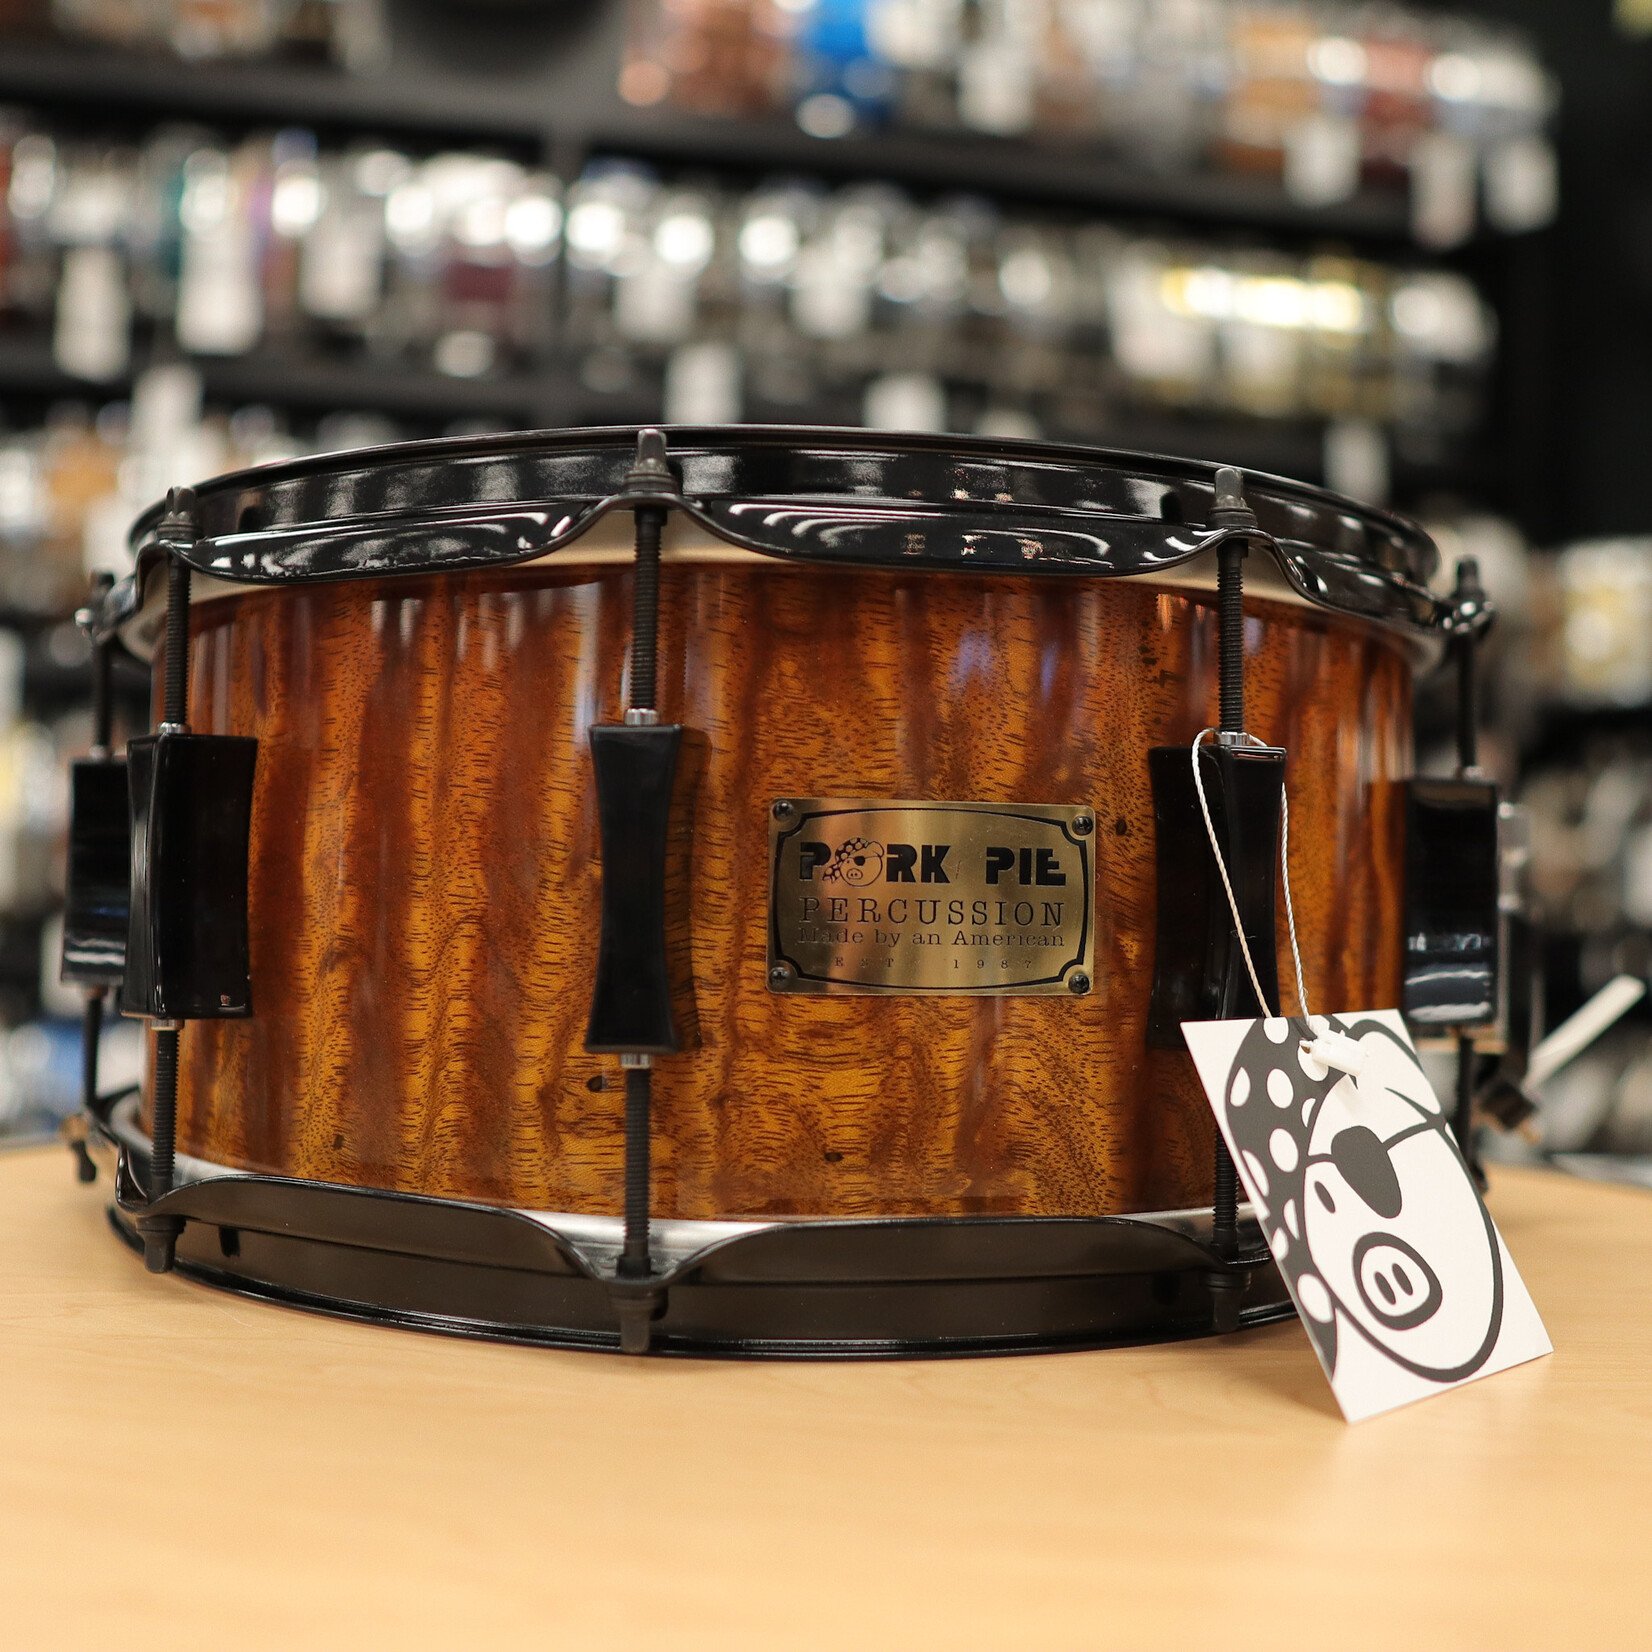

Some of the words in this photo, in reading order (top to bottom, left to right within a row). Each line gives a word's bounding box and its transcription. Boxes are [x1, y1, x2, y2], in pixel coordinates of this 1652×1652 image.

[986, 847, 1066, 887] PIE
[800, 897, 1065, 927] PERCUSSION
[799, 928, 864, 946] Made
[875, 929, 901, 948] by
[912, 933, 941, 946] an
[951, 930, 1065, 947] American
